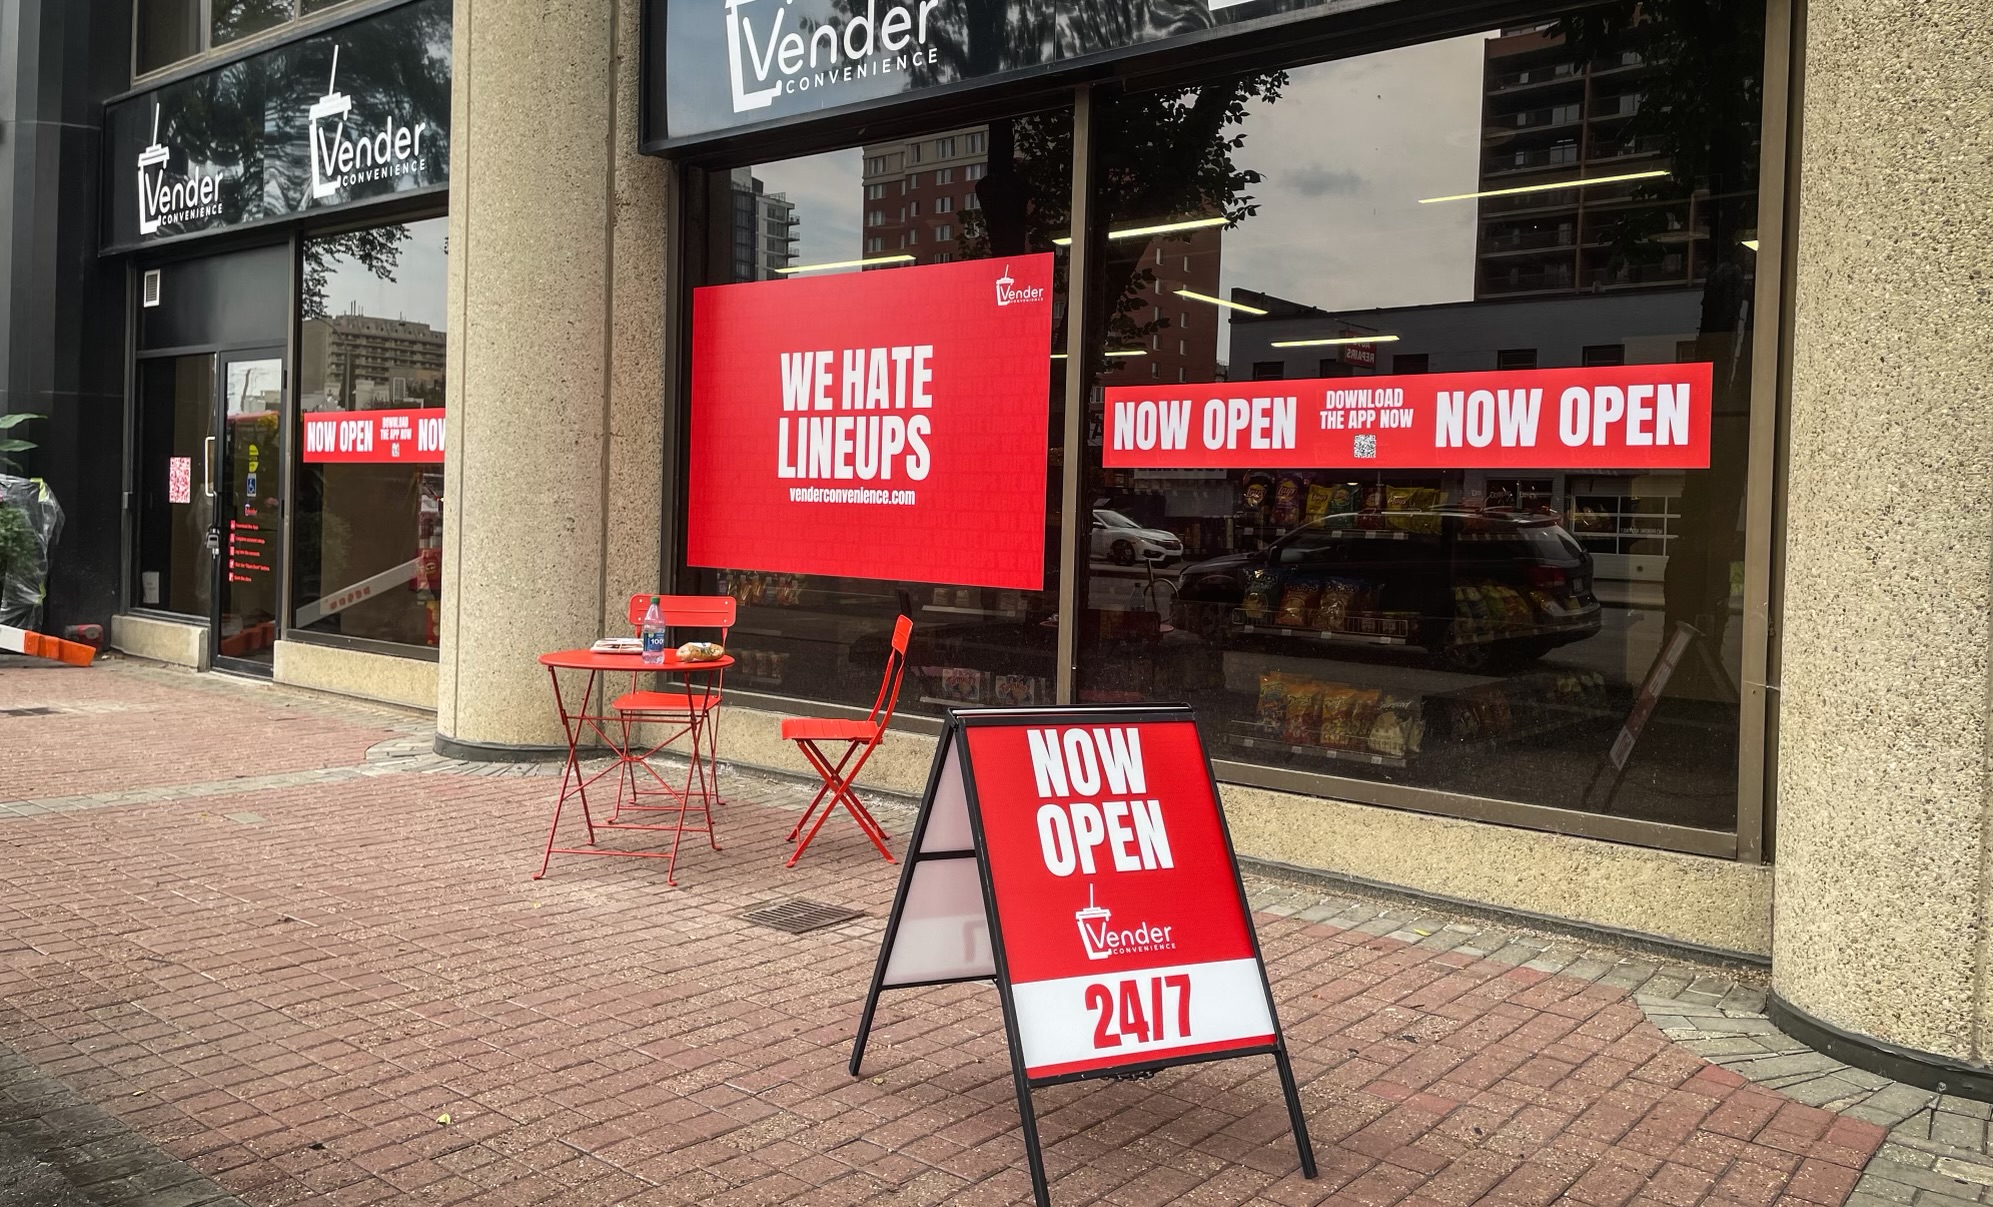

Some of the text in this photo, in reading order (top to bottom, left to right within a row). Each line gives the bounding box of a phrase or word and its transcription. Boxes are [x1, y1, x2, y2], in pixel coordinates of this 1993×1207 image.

[743, 0, 938, 81] Vender
[786, 48, 937, 94] CONVENIENCE
[317, 116, 426, 176] Vender
[145, 166, 223, 215] Vender
[341, 159, 426, 187] CONVENIENCE
[162, 203, 223, 226] CONVENIENCE
[1000, 285, 1044, 300] Vender
[780, 345, 934, 412] WE HATE
[1326, 388, 1404, 409] DOWNLOAD
[307, 420, 373, 452] NOW OPEN
[1113, 397, 1297, 451] NOW OPEN
[1320, 408, 1414, 430] THE APP NOW
[1435, 383, 1691, 448] NOW OPEN
[777, 414, 932, 481] LINEUPS
[789, 486, 916, 506] venderconvenience.com
[1026, 727, 1147, 798] NOW
[1036, 800, 1174, 877] OPEN
[1086, 921, 1172, 949] Vender
[1113, 942, 1176, 955] CONVENIENCE
[1085, 974, 1191, 1049] 24/7
